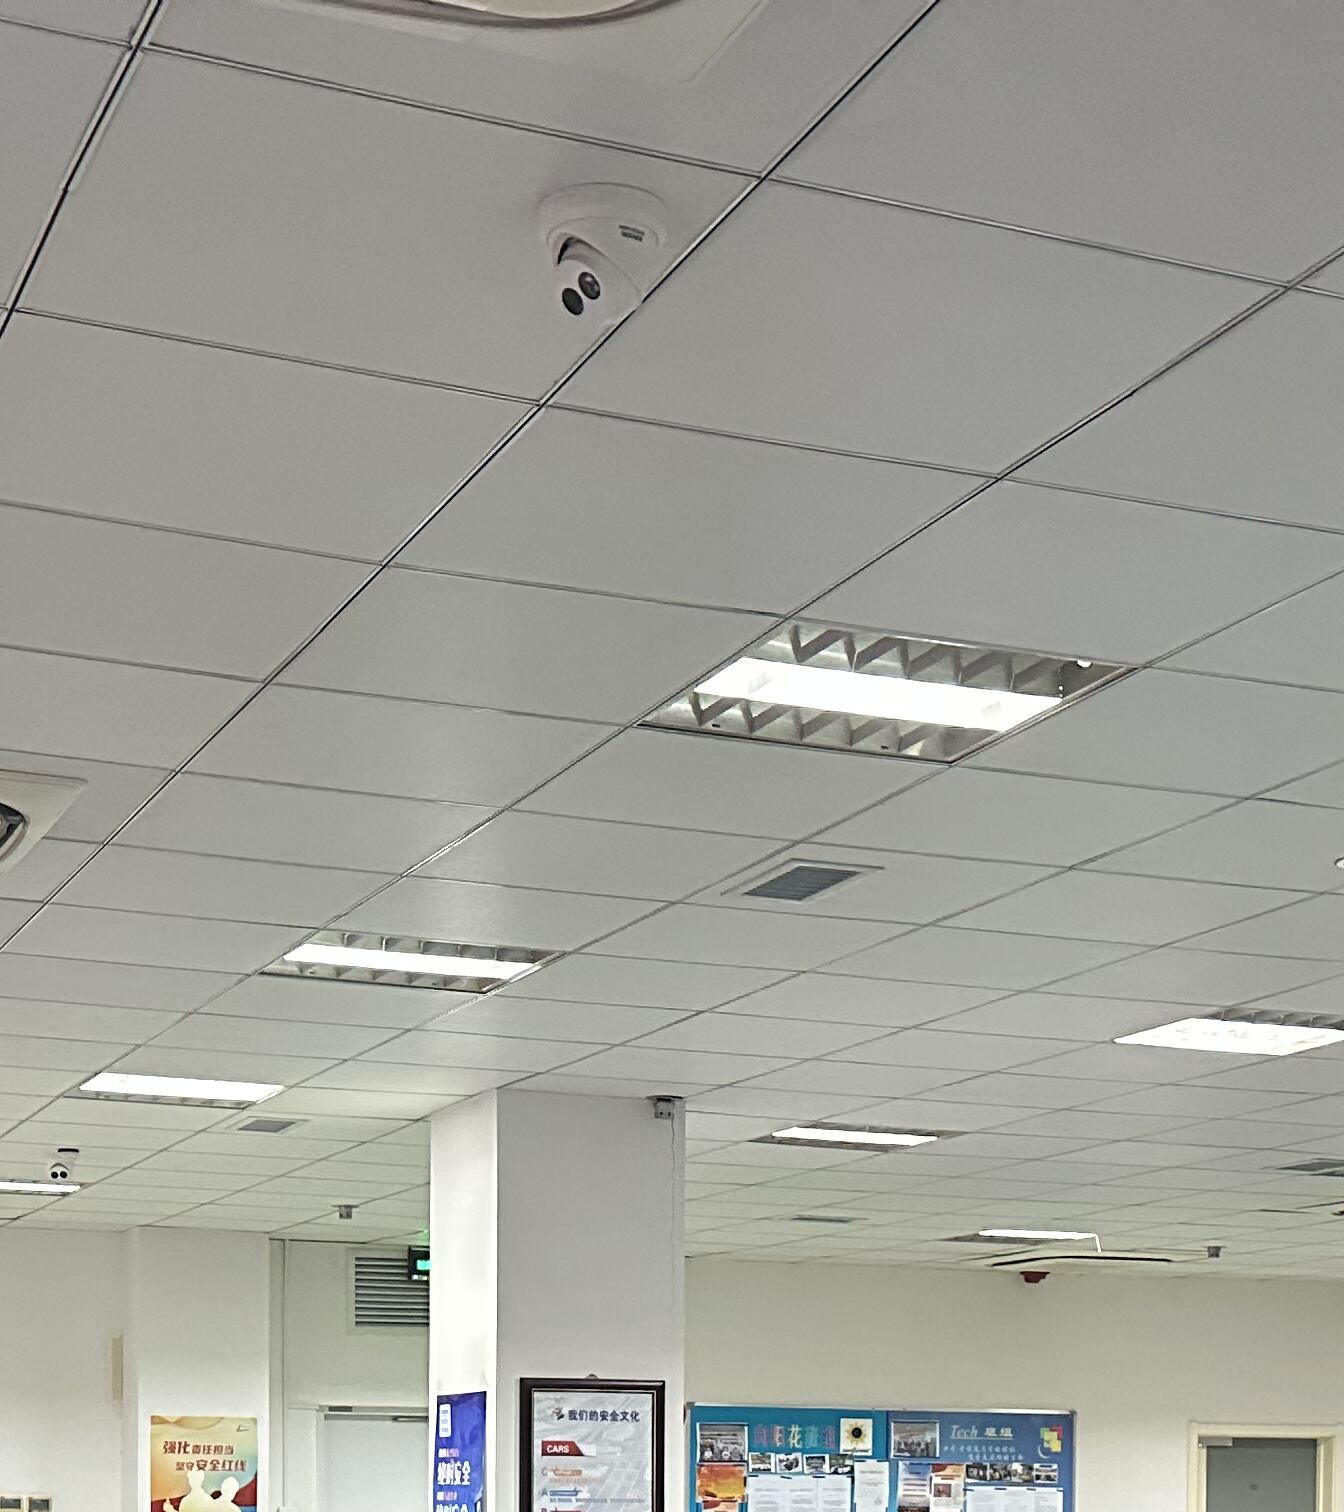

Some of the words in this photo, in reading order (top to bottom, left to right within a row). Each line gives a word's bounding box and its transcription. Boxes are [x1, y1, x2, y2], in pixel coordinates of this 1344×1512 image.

[568, 1409, 640, 1423] 我们的安全文化
[163, 1440, 234, 1456] 强化责任担当
[546, 1444, 570, 1454] CARS
[175, 1459, 247, 1473] 坚守安全红线
